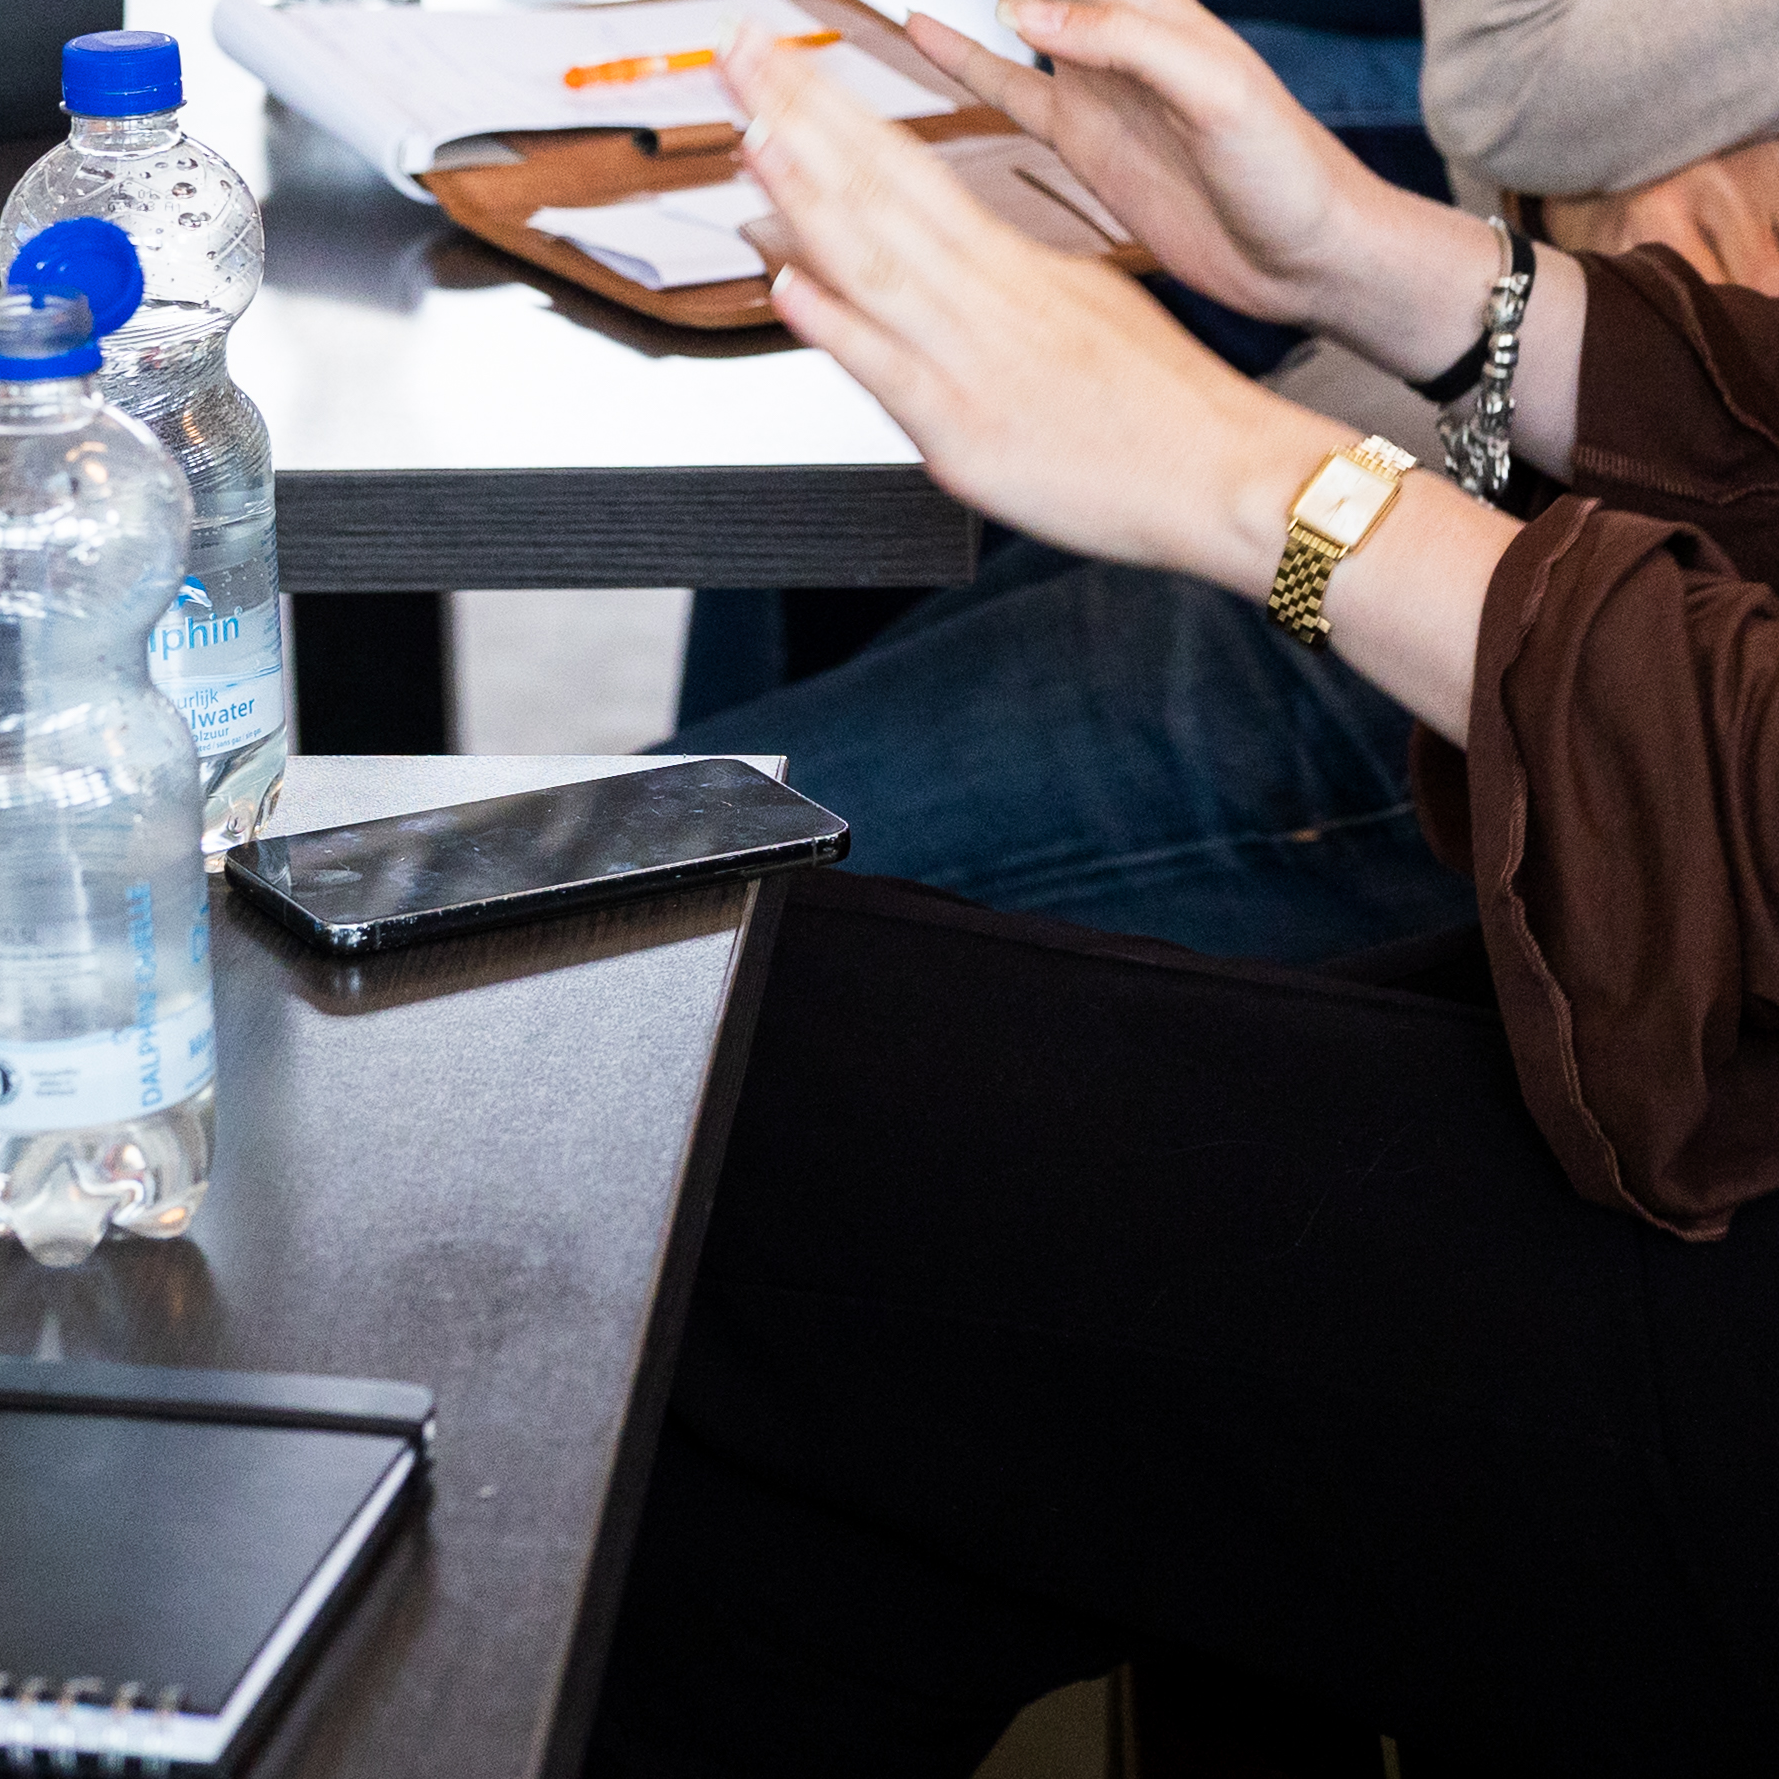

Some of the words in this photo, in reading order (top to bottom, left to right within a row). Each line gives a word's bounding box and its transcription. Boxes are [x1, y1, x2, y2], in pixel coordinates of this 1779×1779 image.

[147, 615, 240, 661] lphin
[176, 688, 219, 710] urlijk
[191, 726, 230, 743] olzuur
